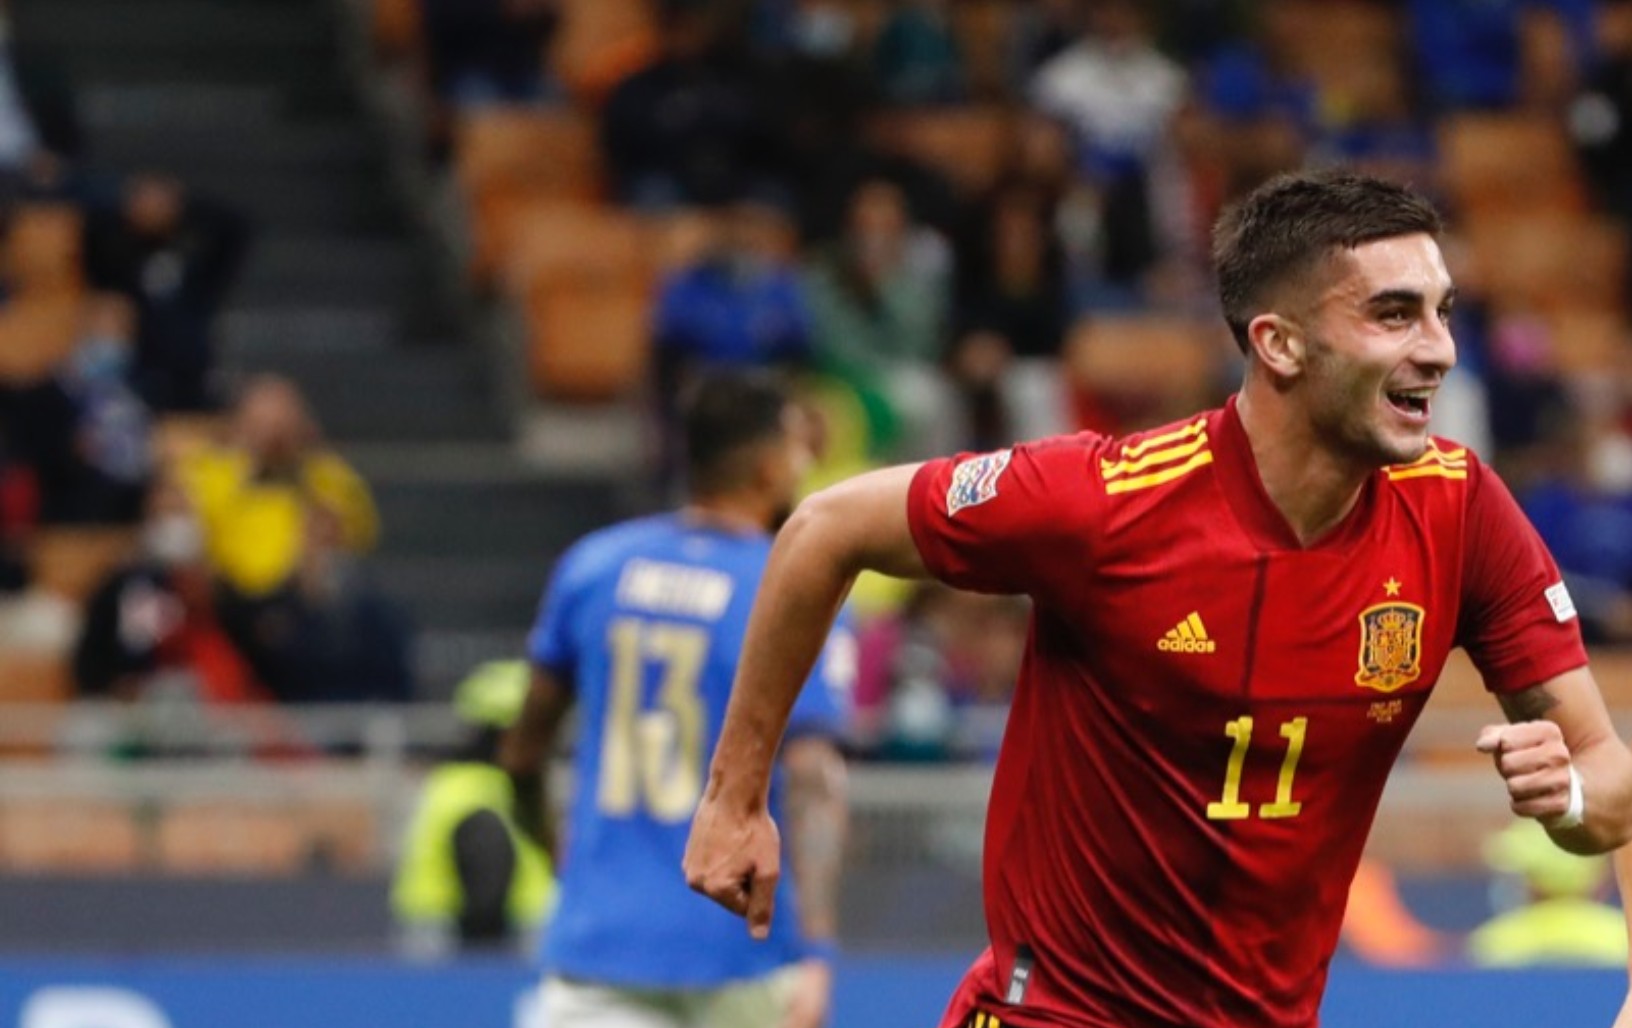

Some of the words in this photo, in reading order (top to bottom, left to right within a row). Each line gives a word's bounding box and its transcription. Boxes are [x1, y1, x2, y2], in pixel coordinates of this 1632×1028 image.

[1157, 637, 1216, 653] adidas
[600, 618, 711, 823] 13
[1206, 716, 1307, 819] 11
